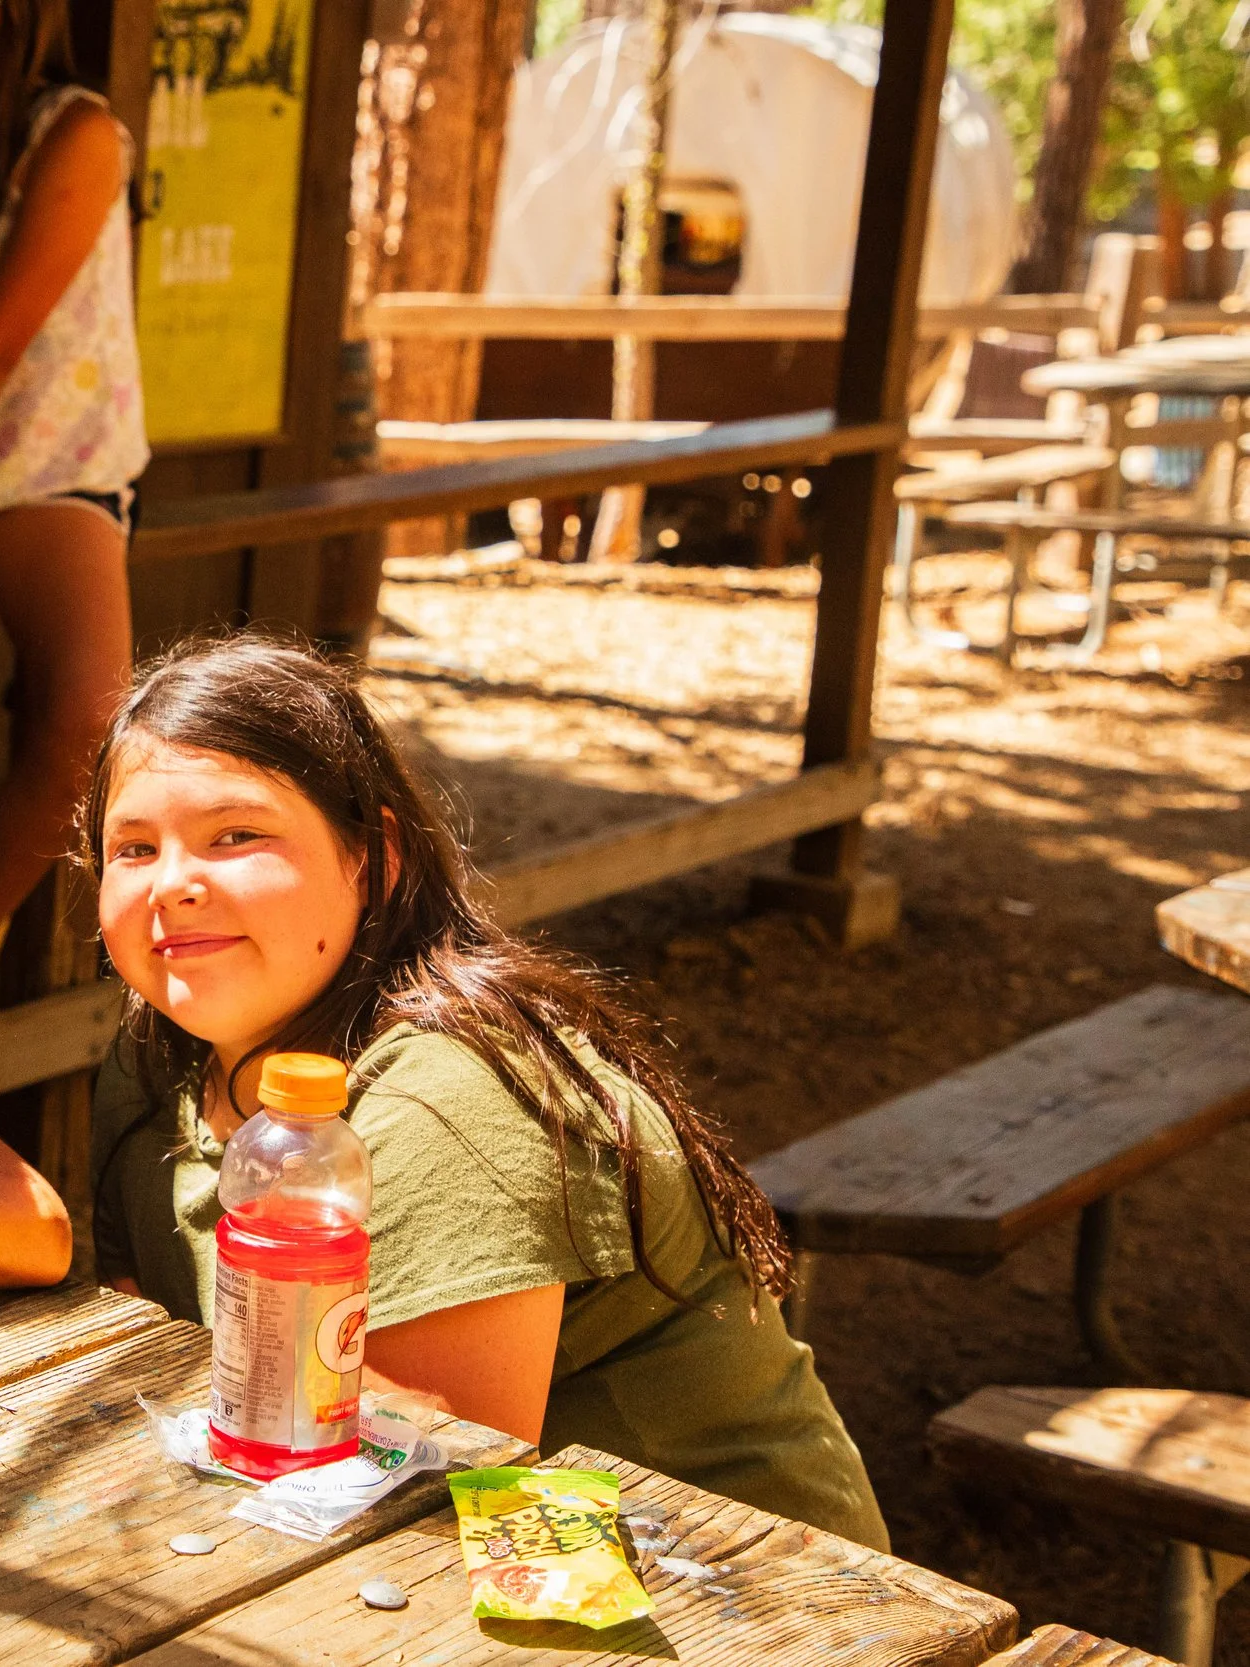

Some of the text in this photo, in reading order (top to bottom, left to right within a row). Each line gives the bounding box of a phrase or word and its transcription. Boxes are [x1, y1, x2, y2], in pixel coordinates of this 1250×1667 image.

[231, 1272, 249, 1288] Facts
[234, 1301, 247, 1317] 140
[498, 1504, 562, 1561] PATCH
[544, 1504, 604, 1553] SOUR
